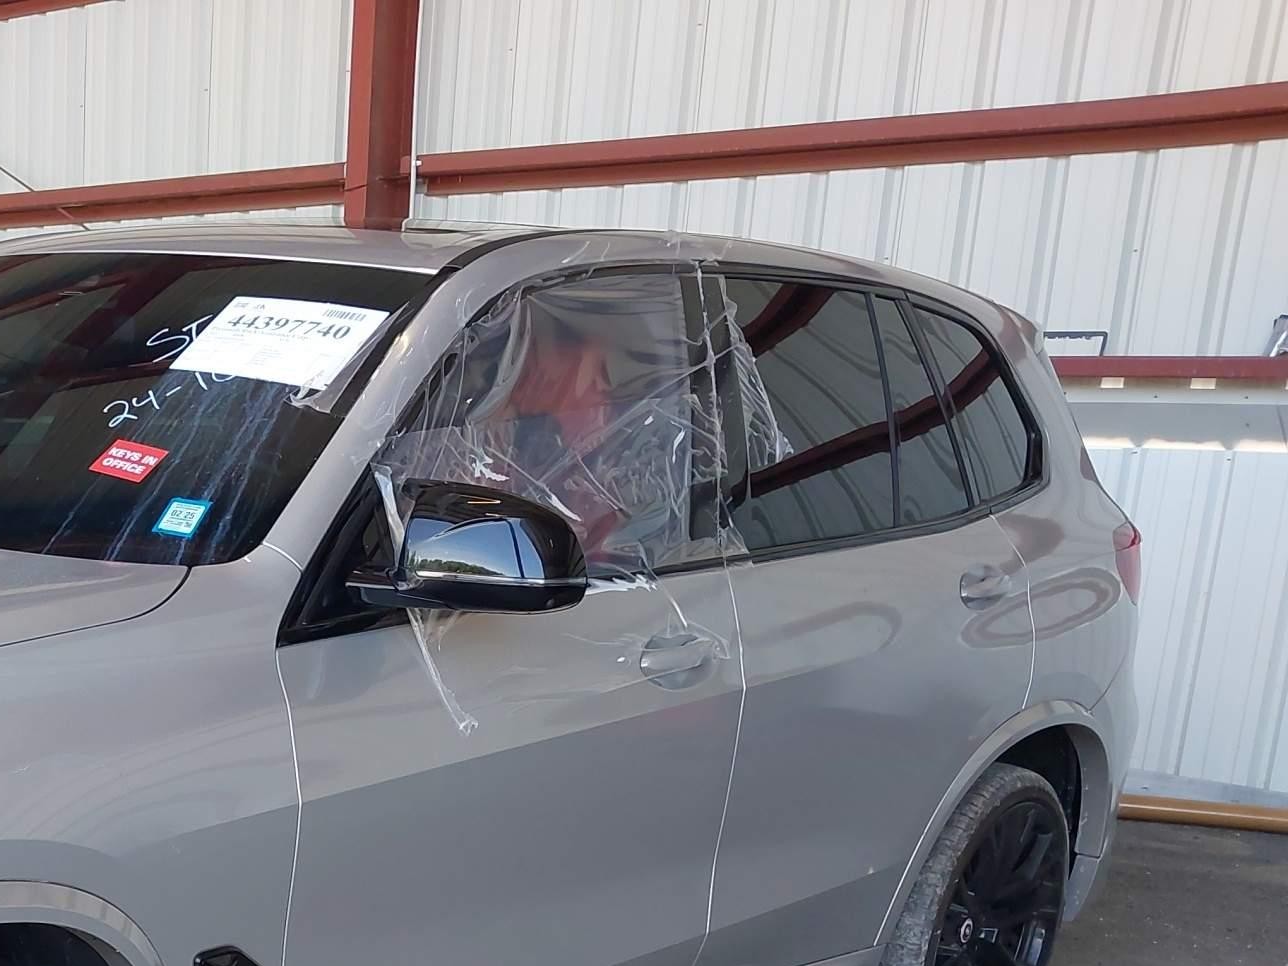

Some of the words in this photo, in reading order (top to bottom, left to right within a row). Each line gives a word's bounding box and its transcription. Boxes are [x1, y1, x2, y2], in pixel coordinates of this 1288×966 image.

[227, 314, 352, 340] 44397740
[101, 456, 147, 475] OFFICE
[108, 446, 142, 462] KEYS
[141, 454, 159, 466] IN
